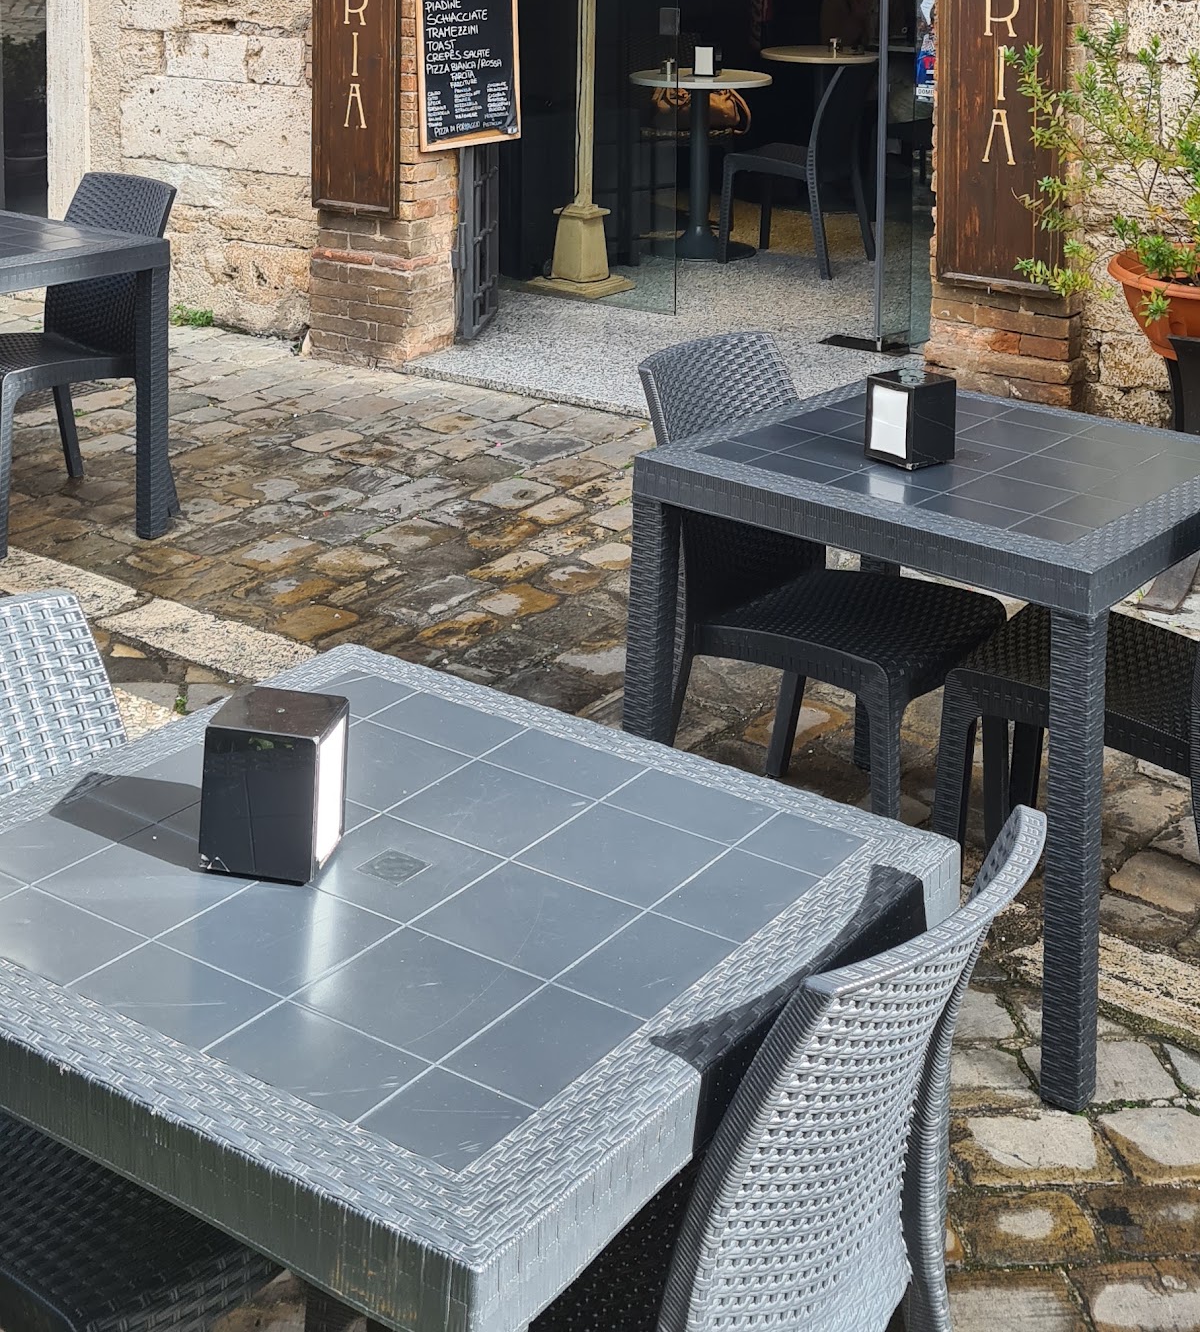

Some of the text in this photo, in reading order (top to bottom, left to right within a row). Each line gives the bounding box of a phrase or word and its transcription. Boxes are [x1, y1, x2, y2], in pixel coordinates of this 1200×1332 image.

[427, 9, 488, 26] SCHIACCIATE
[426, 25, 479, 39] TRAMEZZINI
[426, 39, 457, 52] TOAST
[463, 48, 490, 59] SALATE
[426, 63, 450, 75] PIZZA
[434, 127, 450, 137] PIZZA
[450, 125, 456, 133] DI
